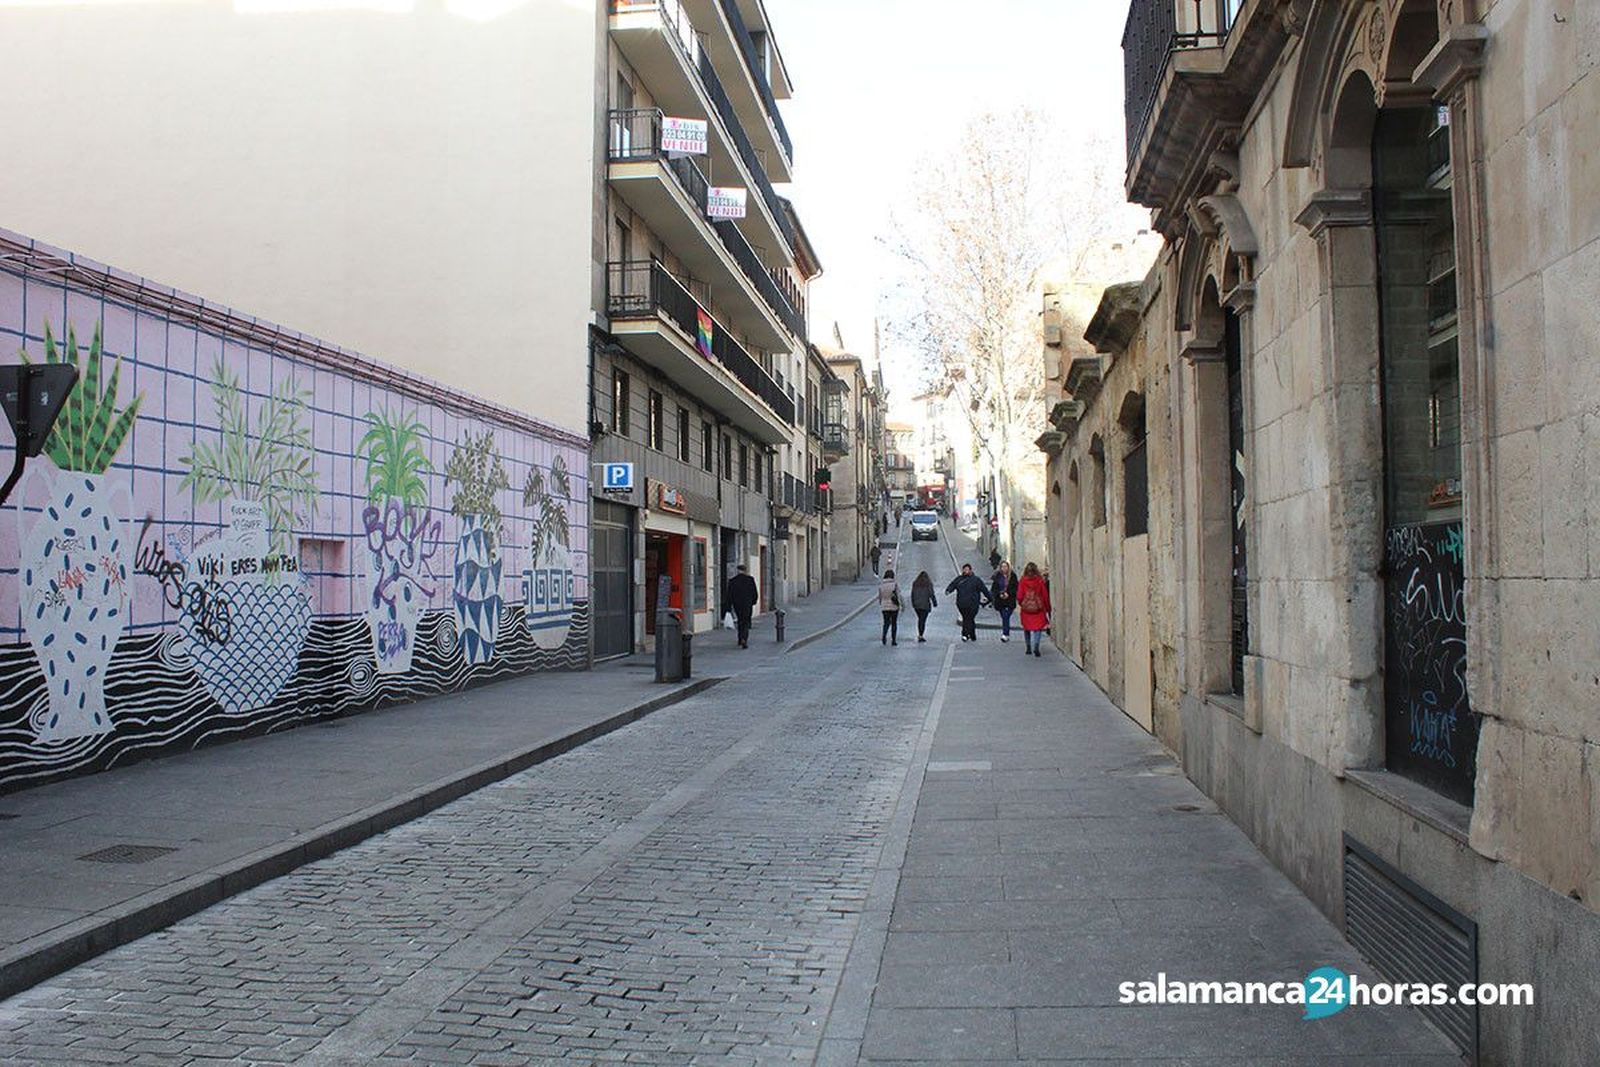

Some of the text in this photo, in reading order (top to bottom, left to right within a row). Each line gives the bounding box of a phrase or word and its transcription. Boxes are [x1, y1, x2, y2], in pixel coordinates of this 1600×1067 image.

[612, 466, 626, 484] P
[231, 557, 258, 576] ERES
[280, 554, 298, 573] FEA
